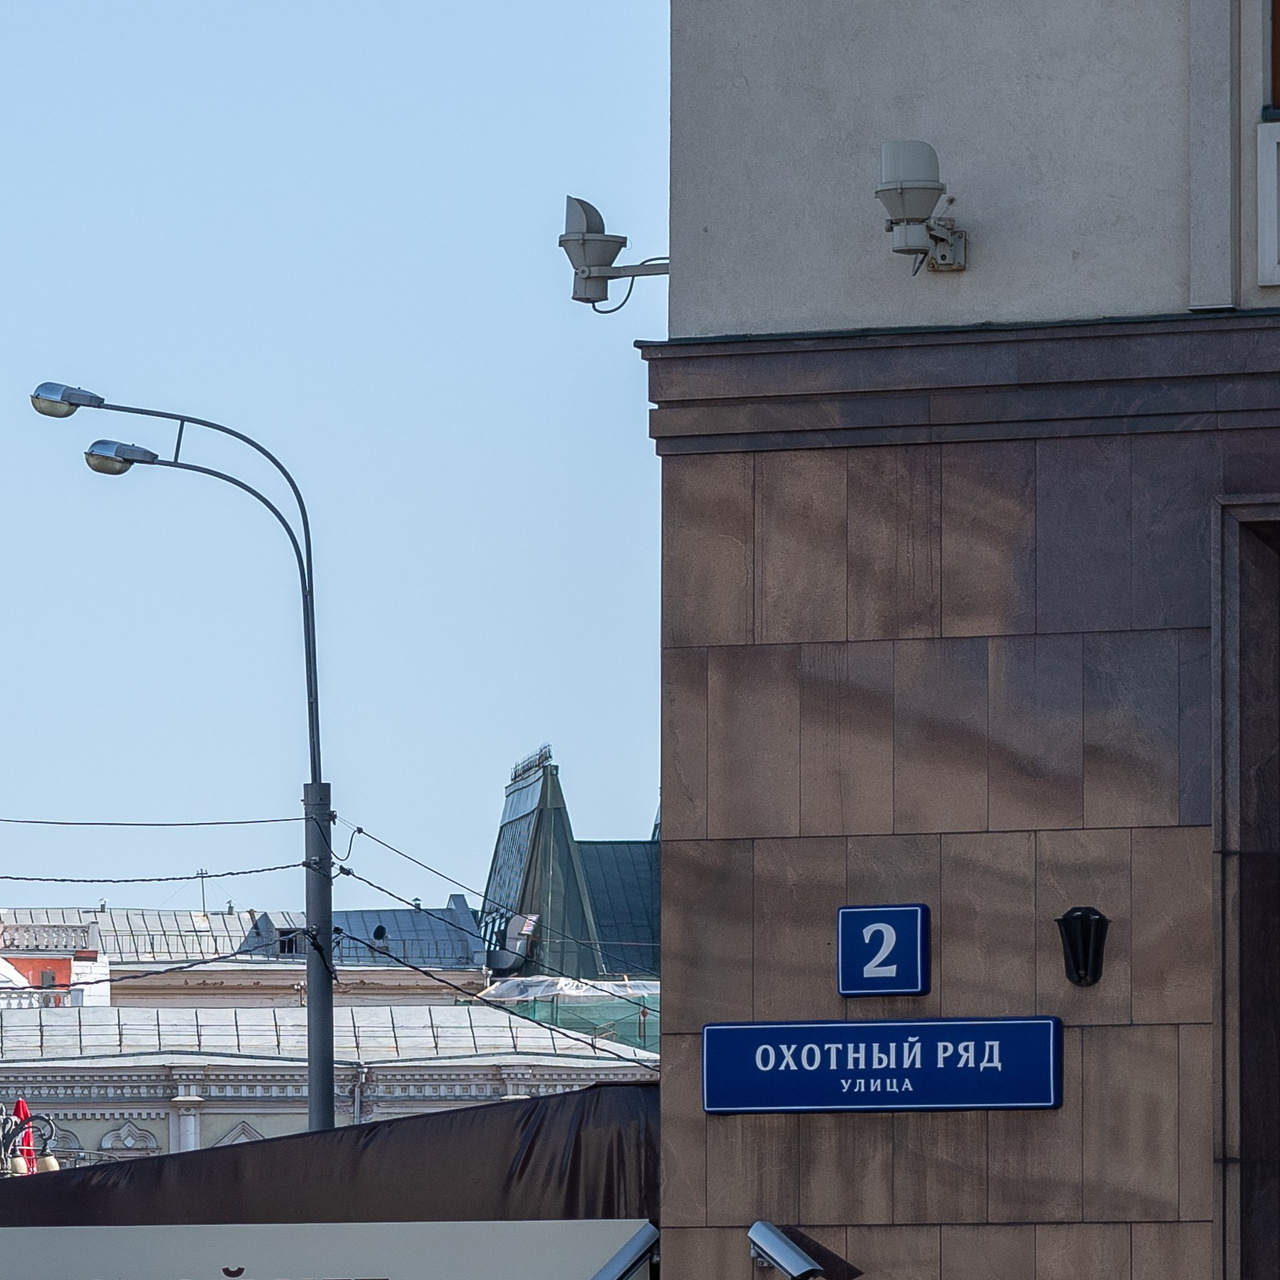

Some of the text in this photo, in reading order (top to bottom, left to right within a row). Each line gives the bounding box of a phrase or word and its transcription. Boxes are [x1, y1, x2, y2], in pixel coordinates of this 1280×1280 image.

[862, 922, 898, 978] 2
[755, 1036, 1002, 1072] ОХОТНЫЙ РЯД
[840, 1078, 914, 1093] УЛИЦА
